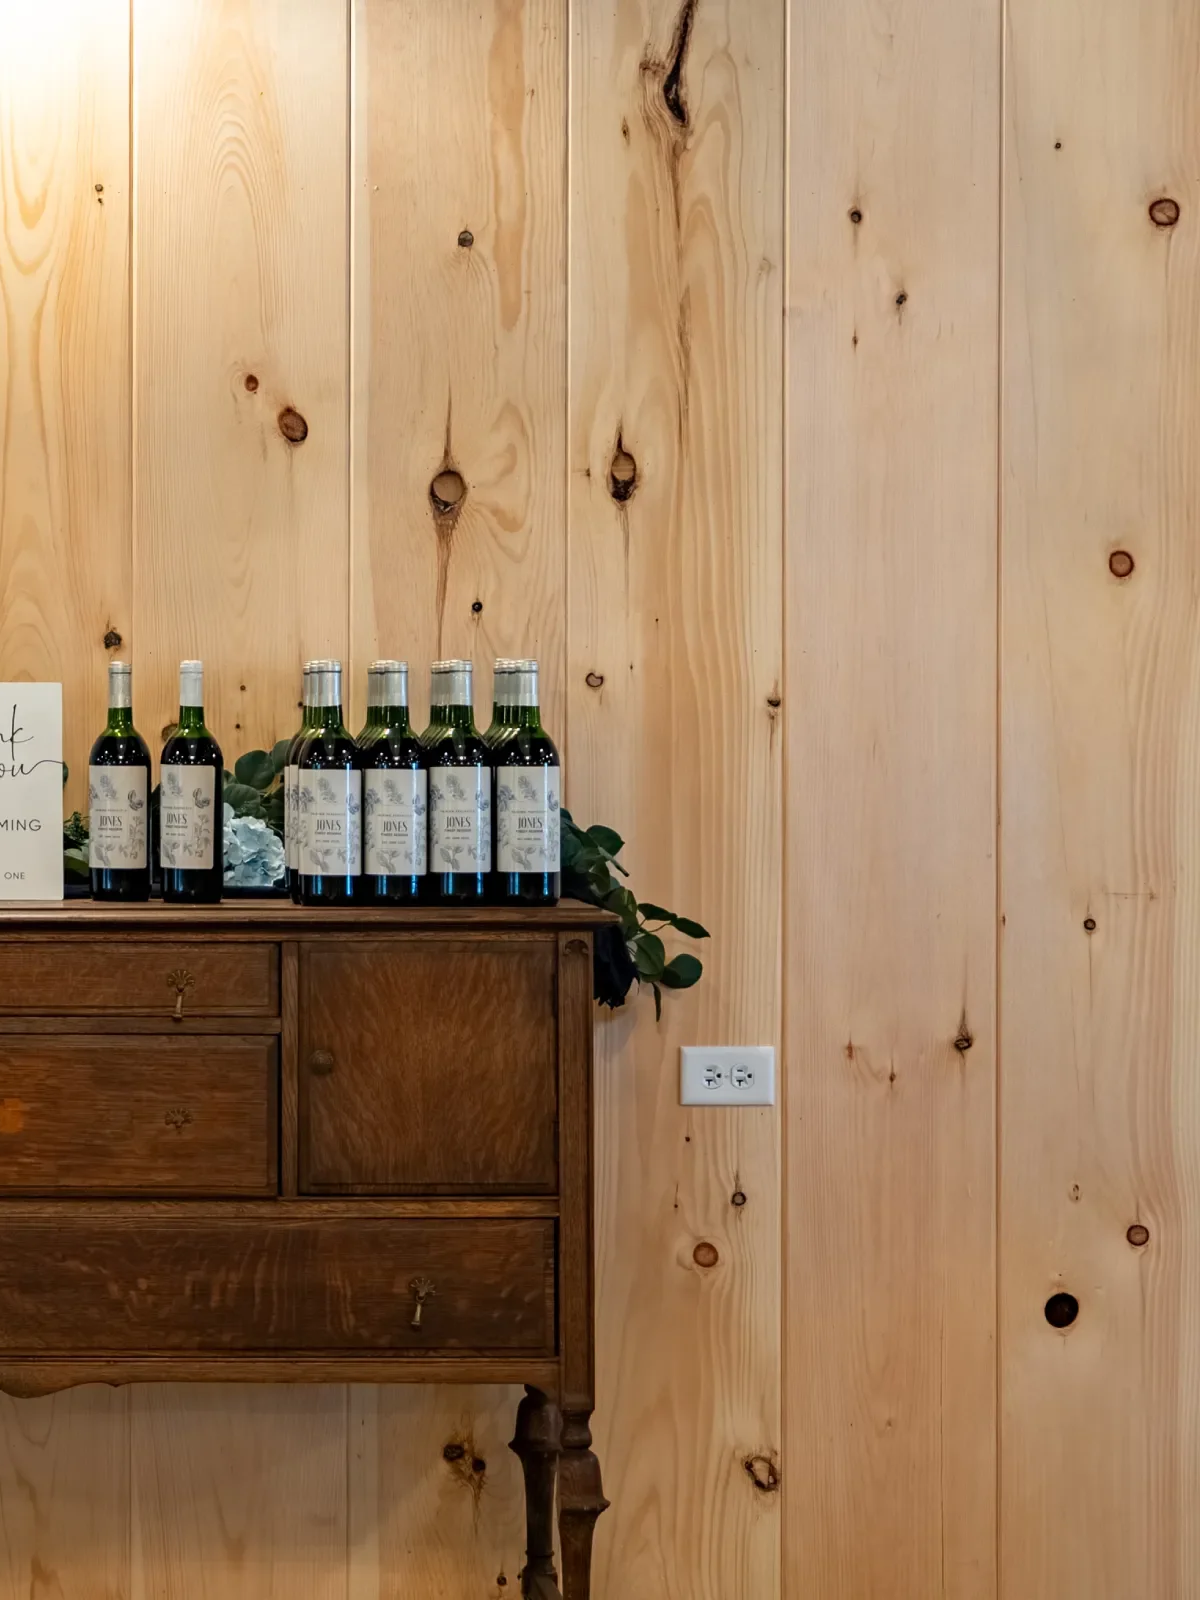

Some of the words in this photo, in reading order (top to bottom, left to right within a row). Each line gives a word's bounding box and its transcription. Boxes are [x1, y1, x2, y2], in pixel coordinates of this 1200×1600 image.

[100, 816, 122, 826] JONES
[166, 813, 187, 824] JONES
[446, 816, 471, 827] JONES
[518, 817, 542, 828] JONES
[316, 820, 341, 830] JONES
[384, 821, 408, 832] JONES
[4, 871, 25, 880] ONE
